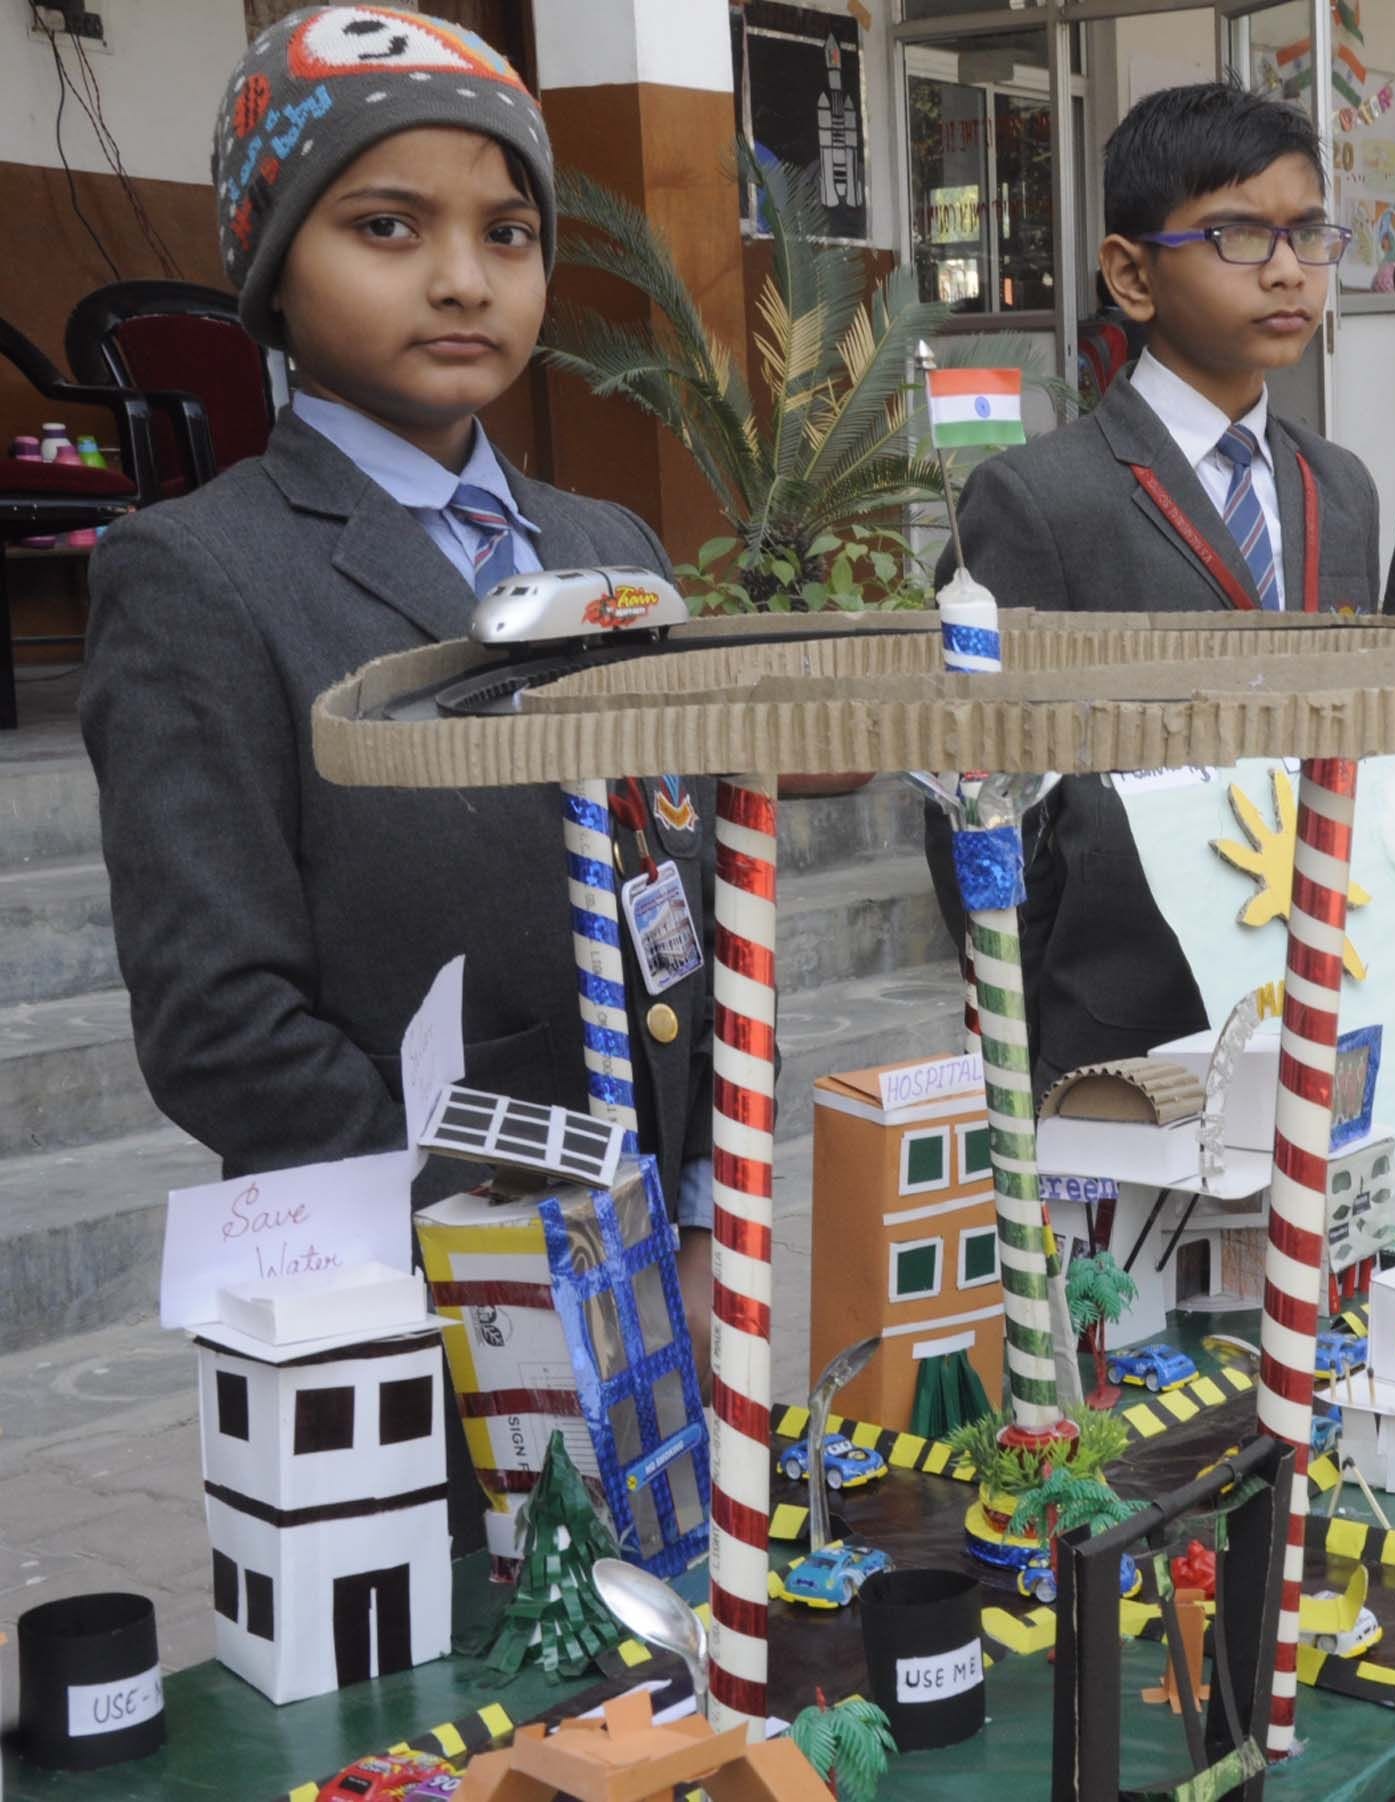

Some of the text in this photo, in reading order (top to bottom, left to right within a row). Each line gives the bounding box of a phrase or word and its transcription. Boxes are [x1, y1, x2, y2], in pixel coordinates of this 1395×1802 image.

[887, 1056, 983, 1102] HOSPITAL
[222, 1181, 311, 1243] Save
[255, 1242, 345, 1280] Water
[508, 1416, 526, 1458] SIGN
[905, 1656, 976, 1689] USE ME
